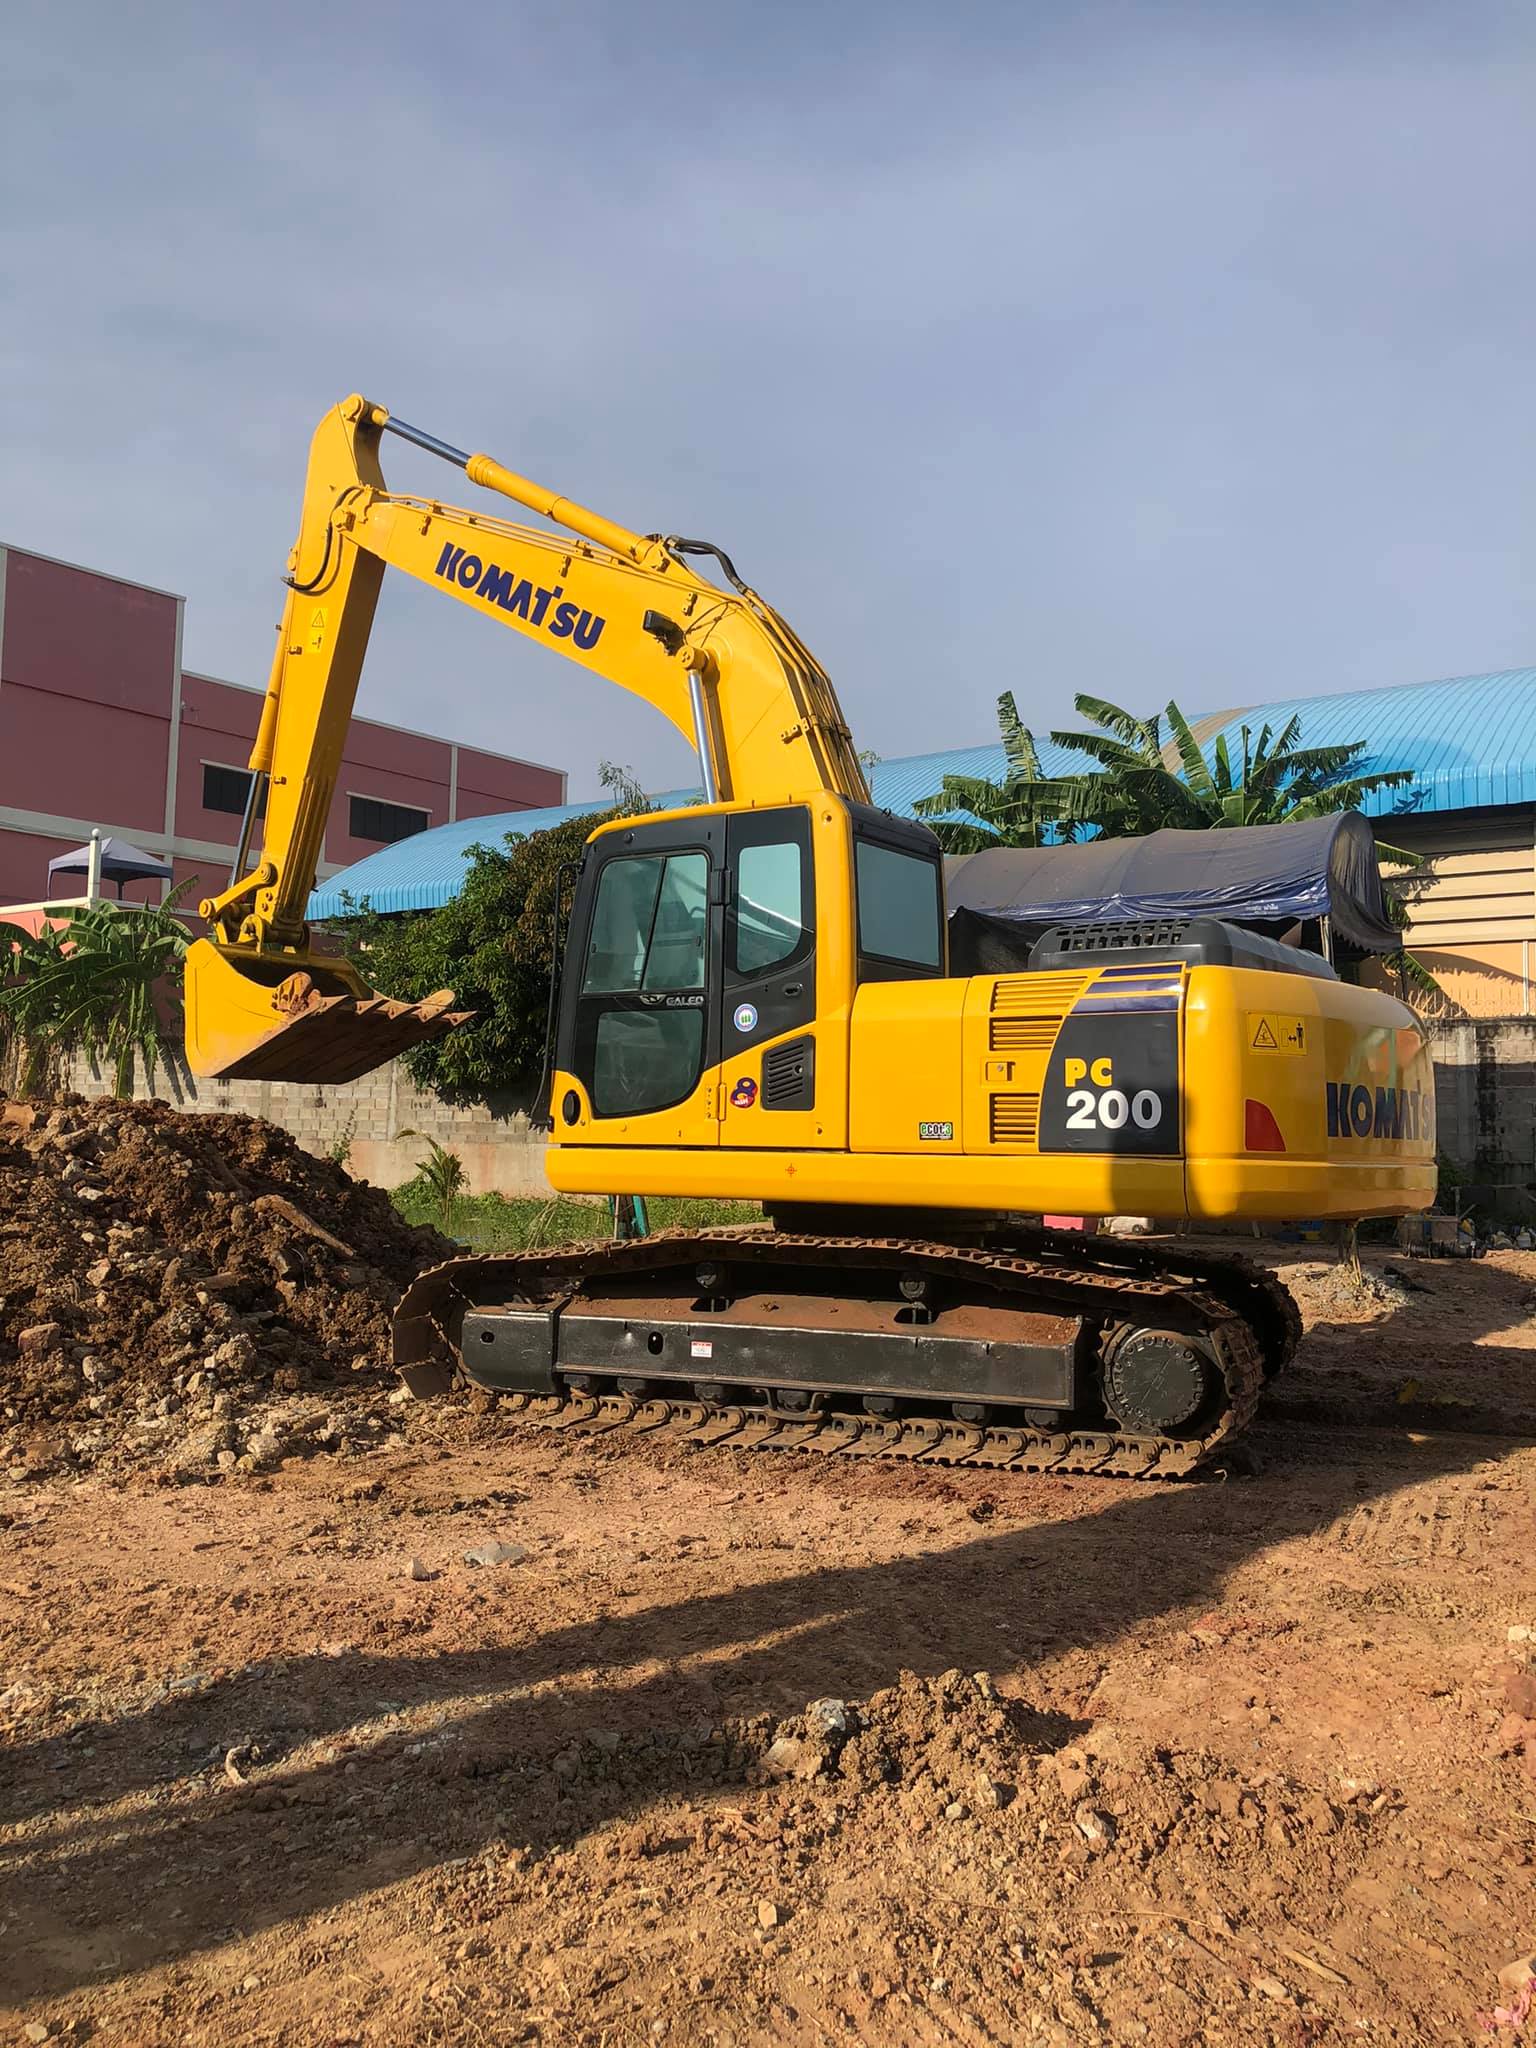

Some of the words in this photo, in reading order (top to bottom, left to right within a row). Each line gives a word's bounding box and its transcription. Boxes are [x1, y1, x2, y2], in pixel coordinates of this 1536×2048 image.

[435, 542, 606, 650] KOMATSU
[666, 995, 704, 1007] GALEO
[1065, 1058, 1112, 1088] PC
[1066, 1090, 1162, 1129] 200
